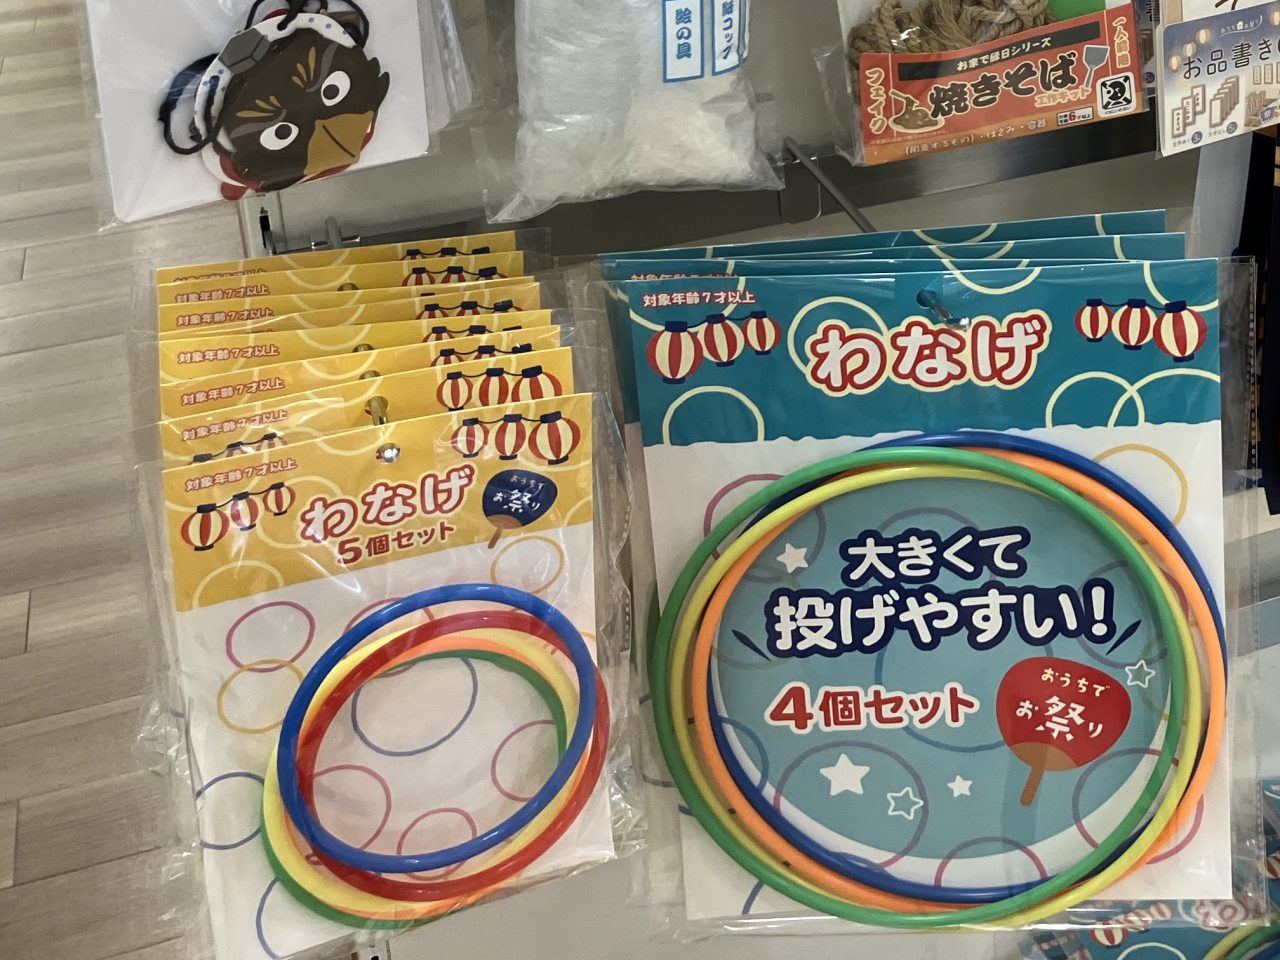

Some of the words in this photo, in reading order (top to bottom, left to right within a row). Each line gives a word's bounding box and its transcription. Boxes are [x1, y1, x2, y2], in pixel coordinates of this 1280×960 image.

[674, 6, 692, 60] 絵の具
[956, 37, 1052, 72] お家で縁日シリーズ
[1182, 38, 1273, 80] お品書き
[865, 67, 889, 135] フェイク
[928, 49, 1080, 121] 焼きそば
[1034, 86, 1093, 109] 工作キット
[1068, 111, 1077, 122] 6
[642, 289, 756, 308] 対象年齢7才以上
[178, 343, 281, 364] 対象年齢7才以上
[806, 312, 1048, 392] わなげ
[181, 377, 285, 406] 対象年齢7才以上
[184, 458, 299, 493] 対象年齢7才以上
[301, 463, 476, 545] わなげ
[492, 488, 542, 515] お祭り
[336, 522, 456, 565] 5個セット
[847, 531, 1025, 582] 大きくて
[1040, 666, 1111, 695] おうちで
[767, 683, 979, 731] 4個セット
[1014, 694, 1105, 742] お祭り
